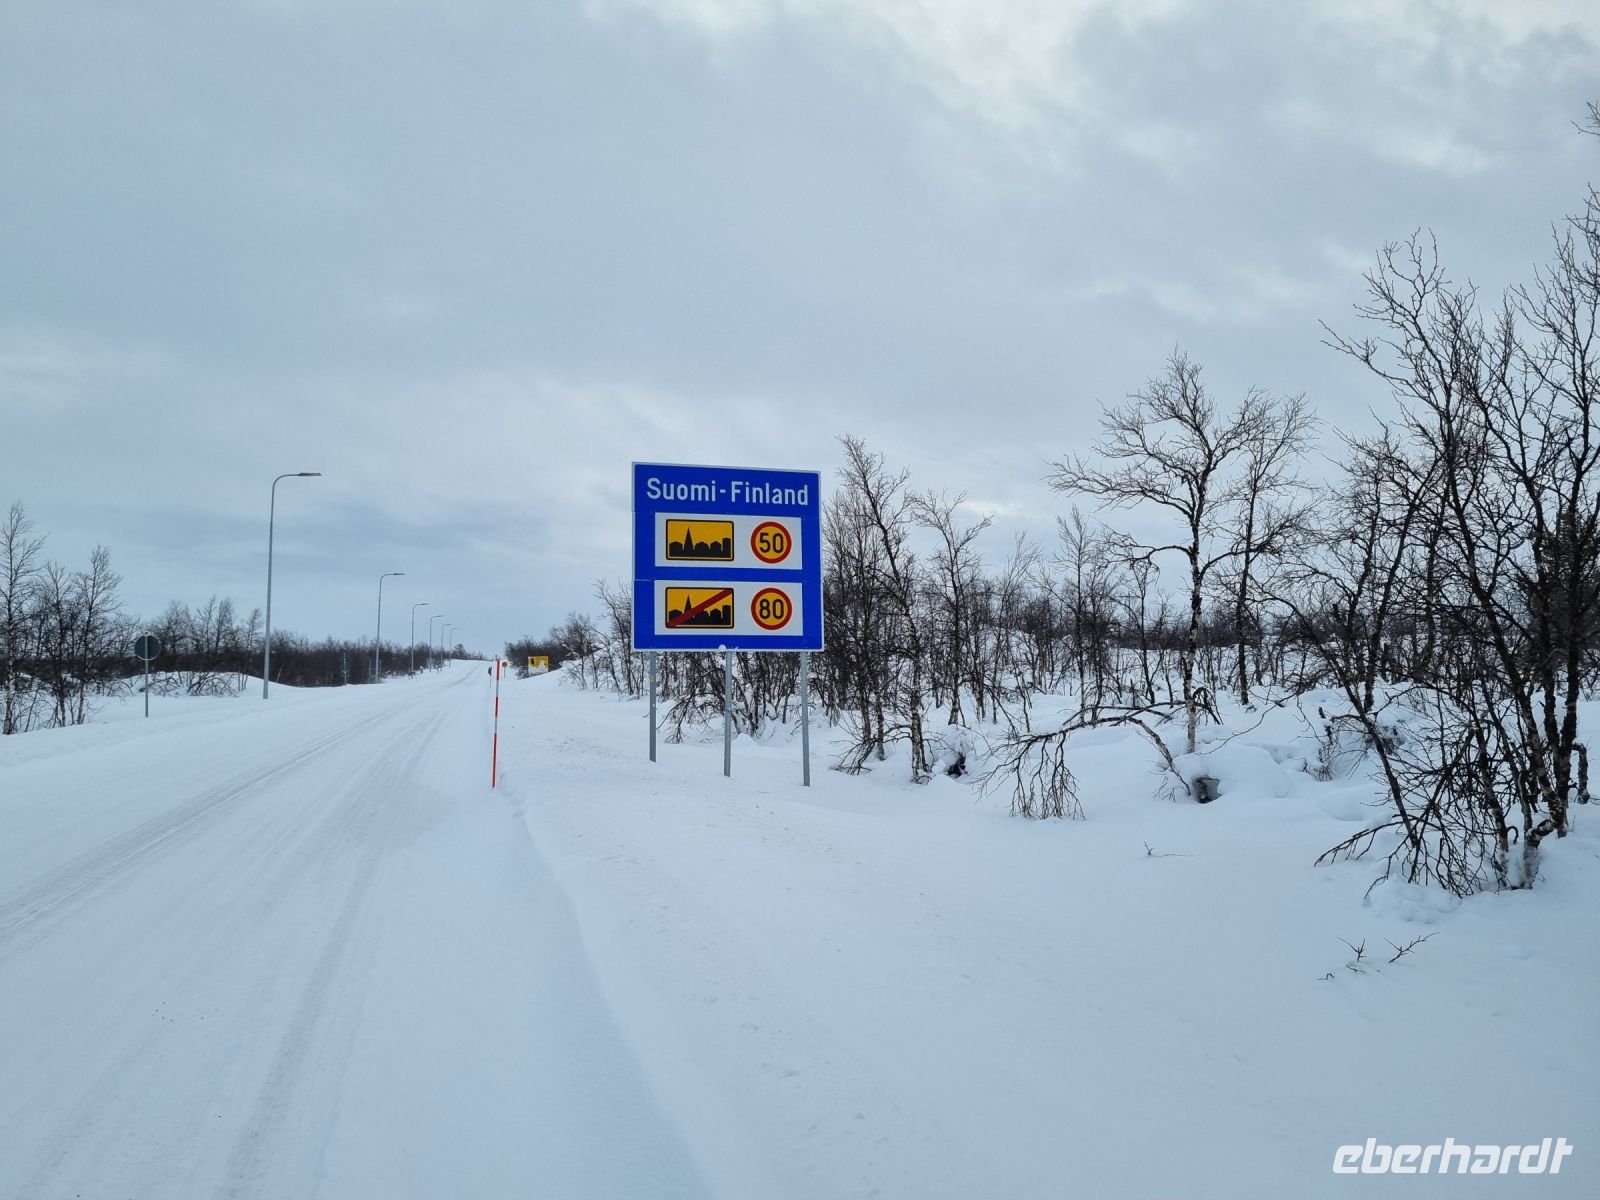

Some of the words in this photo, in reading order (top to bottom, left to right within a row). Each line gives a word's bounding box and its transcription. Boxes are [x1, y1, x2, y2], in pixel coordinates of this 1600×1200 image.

[647, 477, 809, 506] Suomi-Finland
[759, 532, 784, 554] 50
[759, 598, 785, 620] 80
